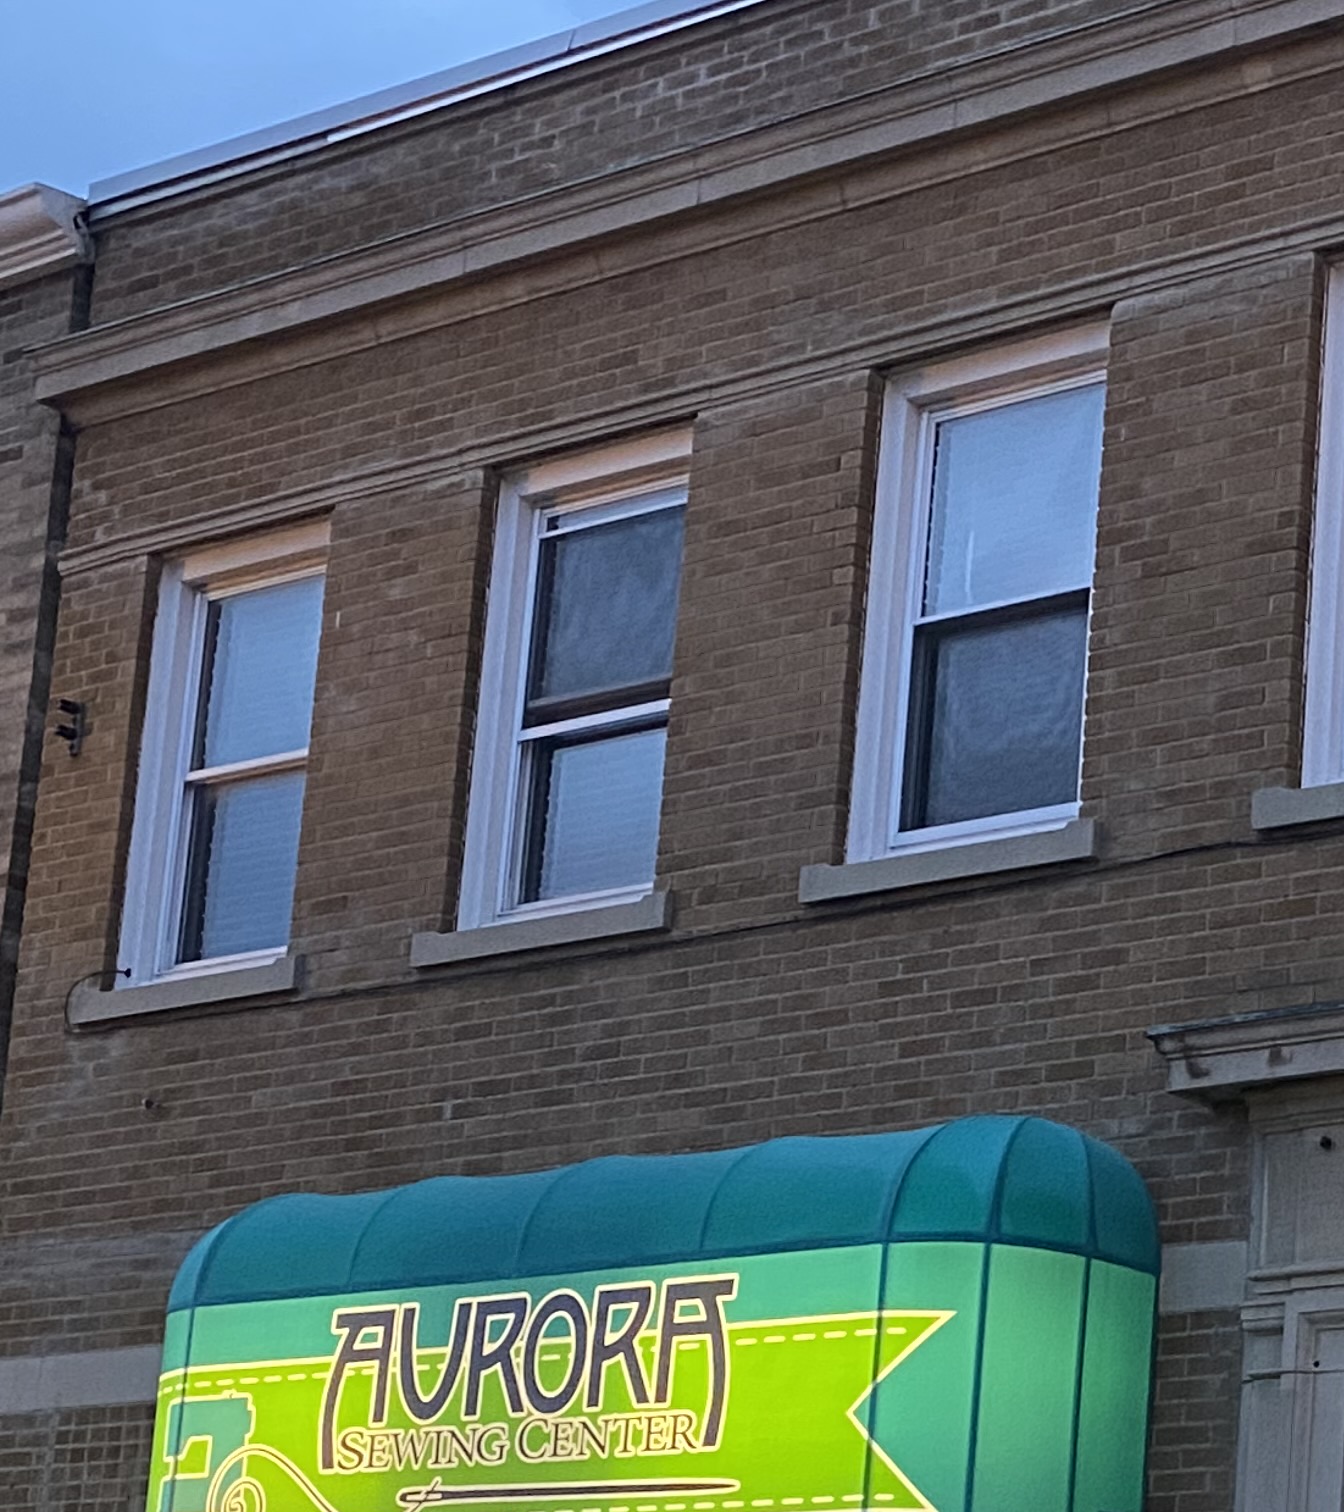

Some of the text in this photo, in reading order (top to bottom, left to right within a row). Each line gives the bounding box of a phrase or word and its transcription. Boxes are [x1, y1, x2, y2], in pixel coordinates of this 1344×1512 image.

[320, 1274, 738, 1472] AURORA
[336, 1412, 698, 1471] SEWING CENTER
